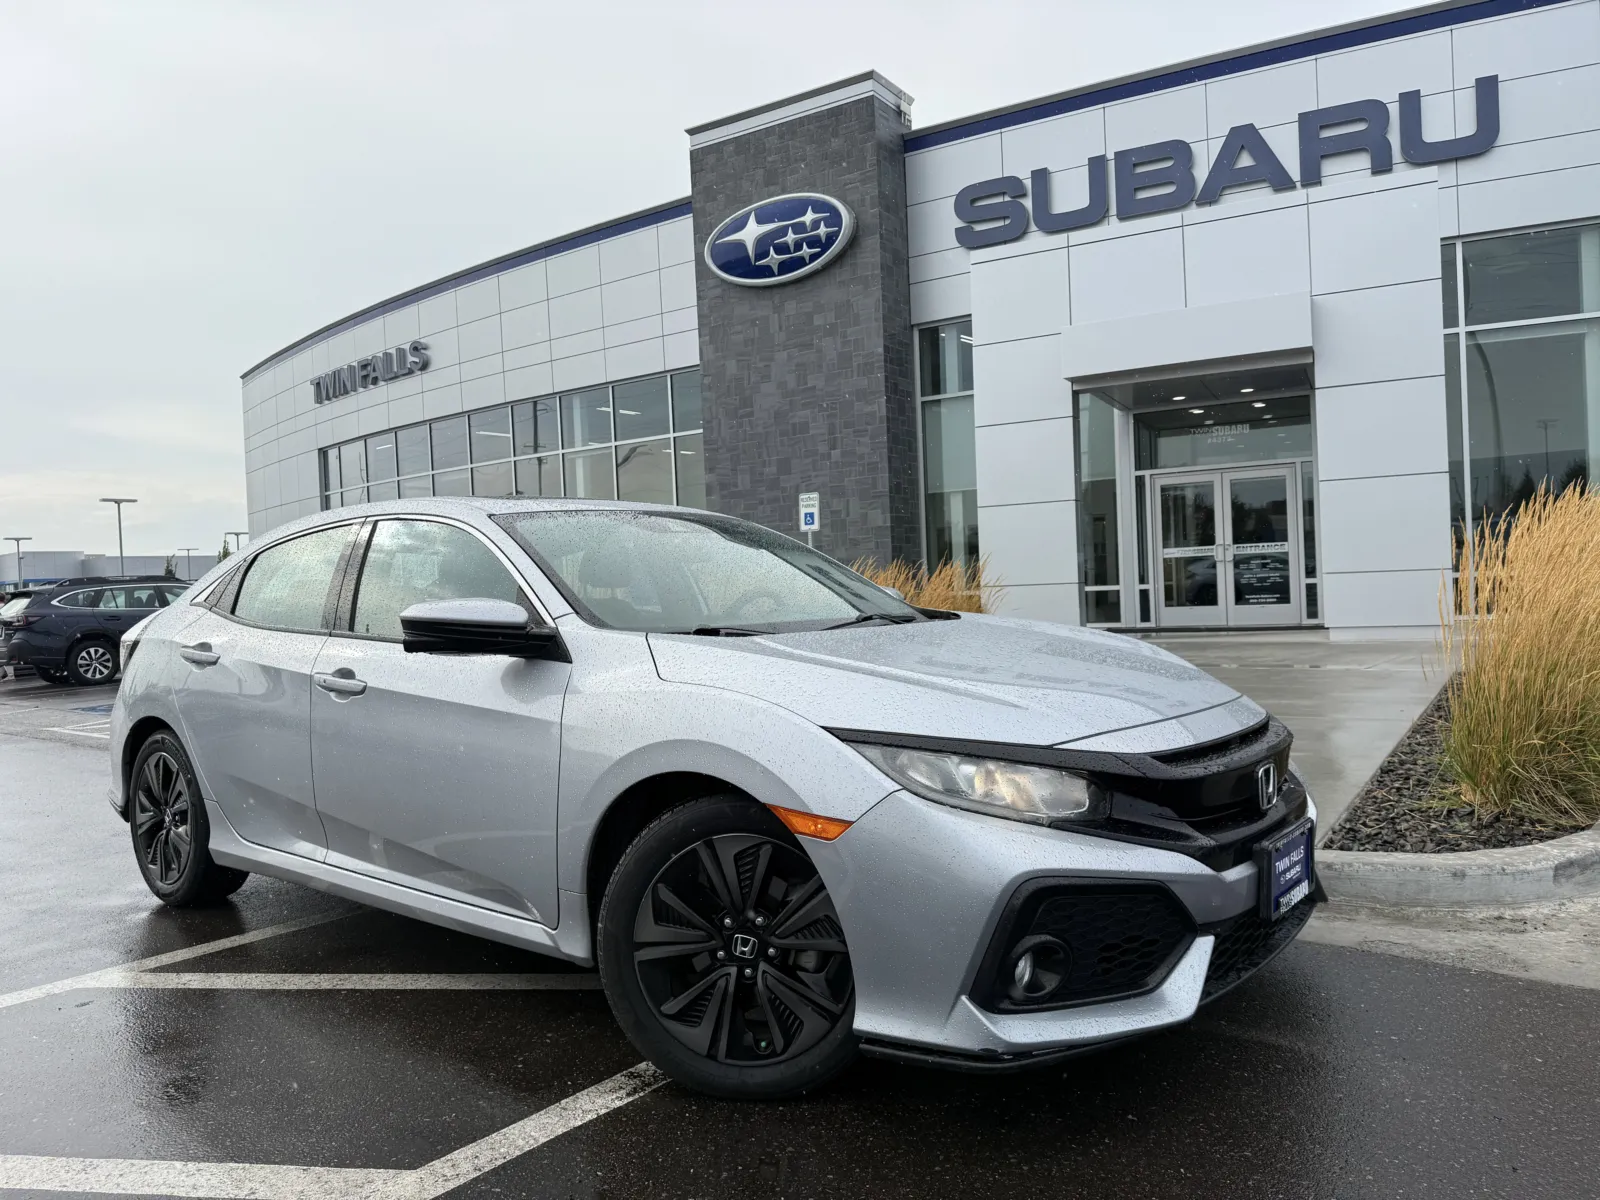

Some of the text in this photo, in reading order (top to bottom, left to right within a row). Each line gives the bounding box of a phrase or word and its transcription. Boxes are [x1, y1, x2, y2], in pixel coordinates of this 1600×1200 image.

[954, 73, 1500, 249] SUBARU
[310, 340, 430, 404] TWIN FALLS
[1212, 423, 1250, 436] SUBARU
[1236, 543, 1286, 552] ENTRANCE
[1275, 845, 1304, 874] TWIN FALLS
[1285, 863, 1302, 880] SUBARU
